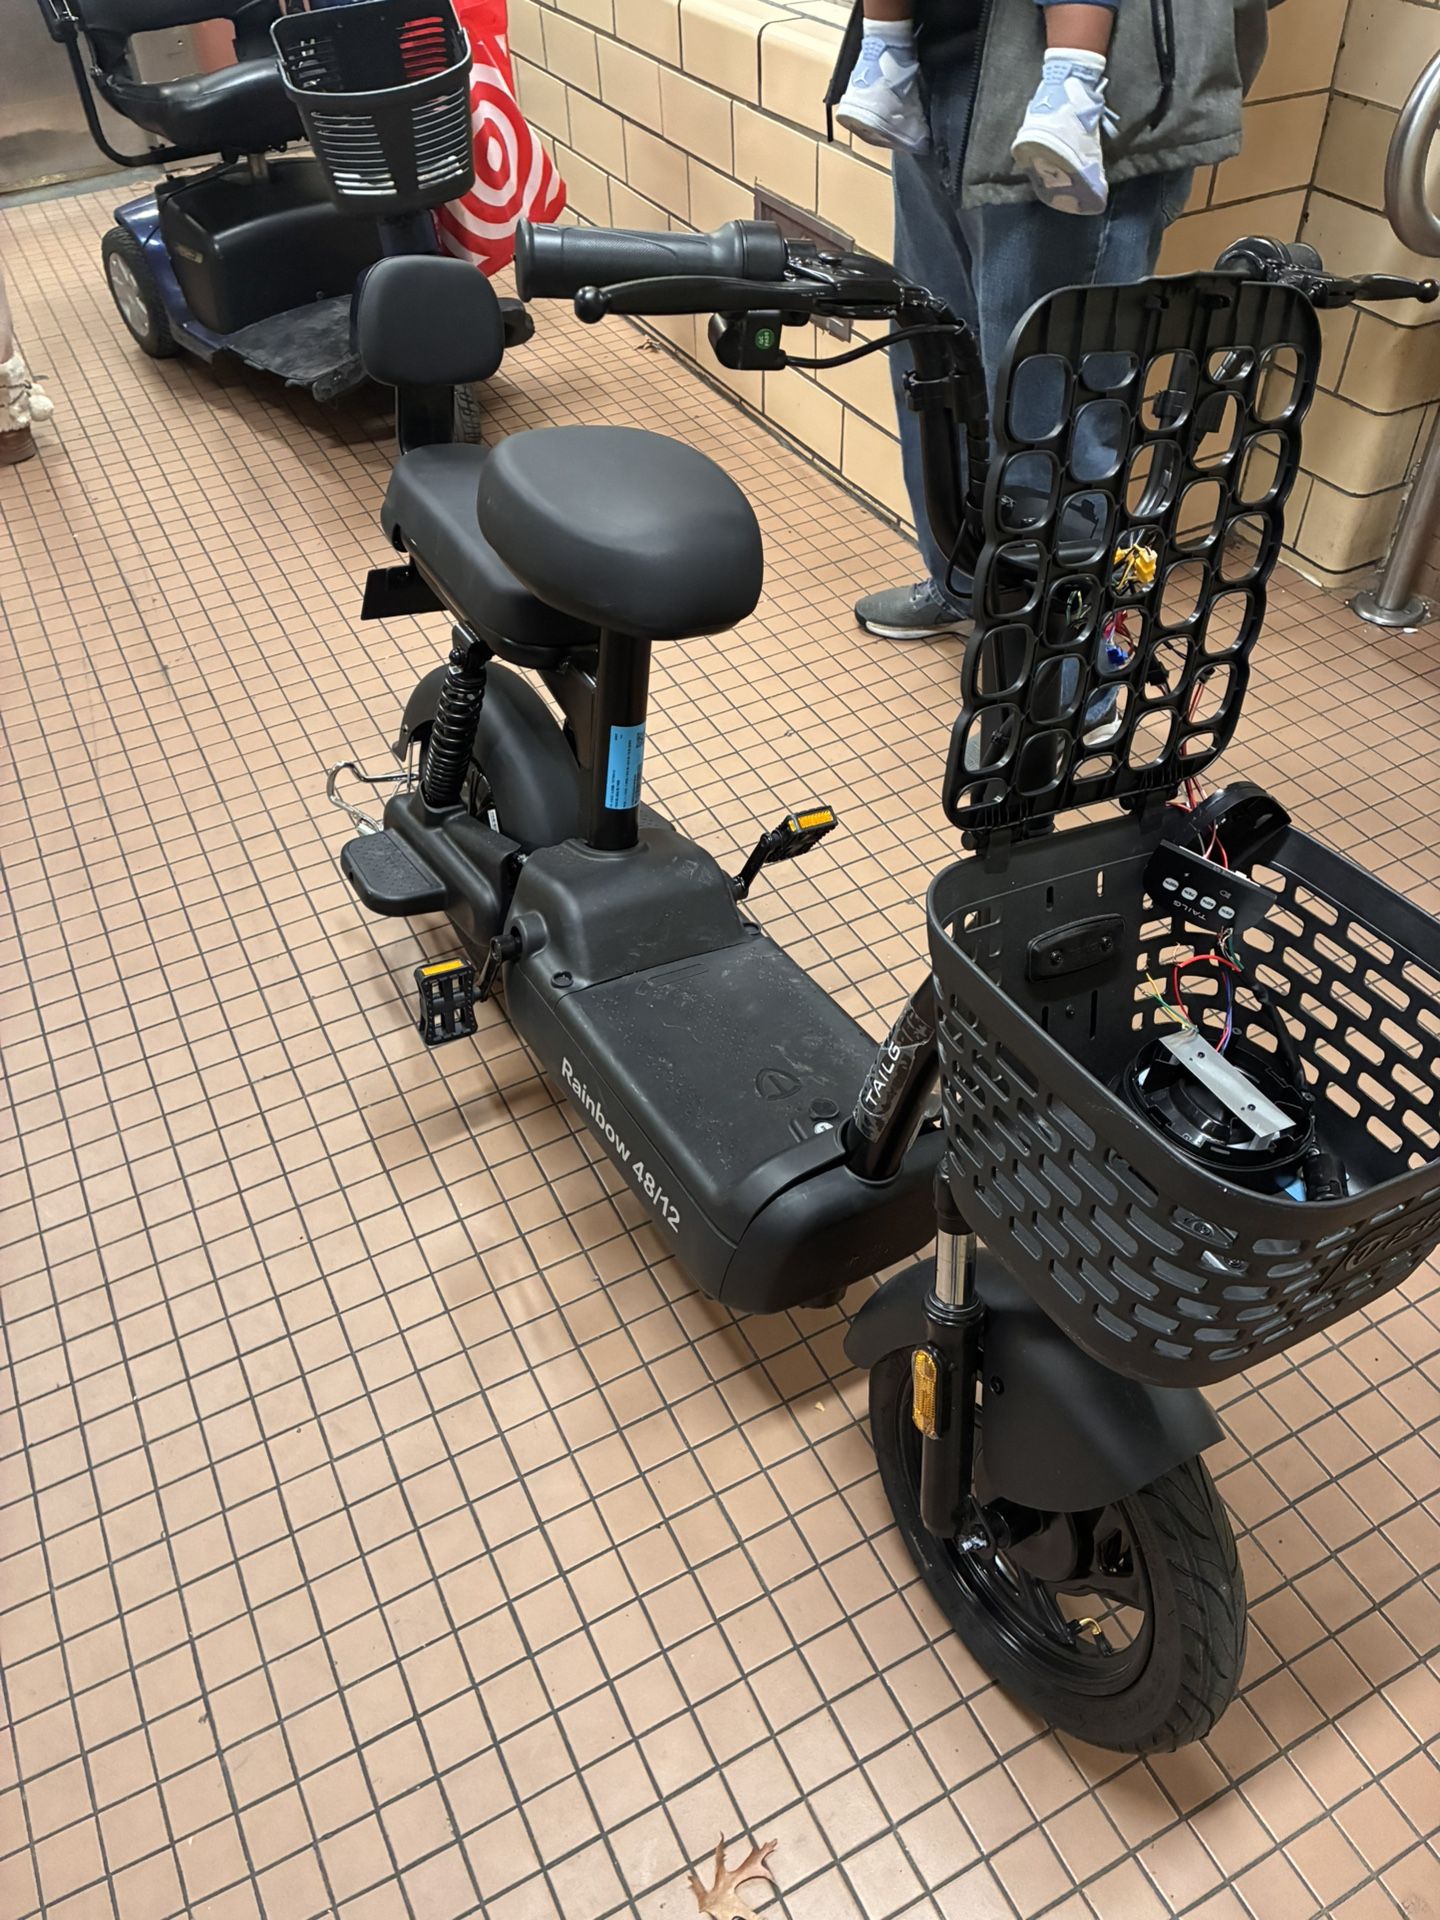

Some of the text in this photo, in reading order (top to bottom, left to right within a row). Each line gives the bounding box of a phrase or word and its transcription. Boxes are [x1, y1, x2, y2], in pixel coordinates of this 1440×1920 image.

[1173, 900, 1206, 920] TAILG
[865, 1041, 901, 1106] TAILG
[561, 1056, 680, 1233] Rainbow 48/12
